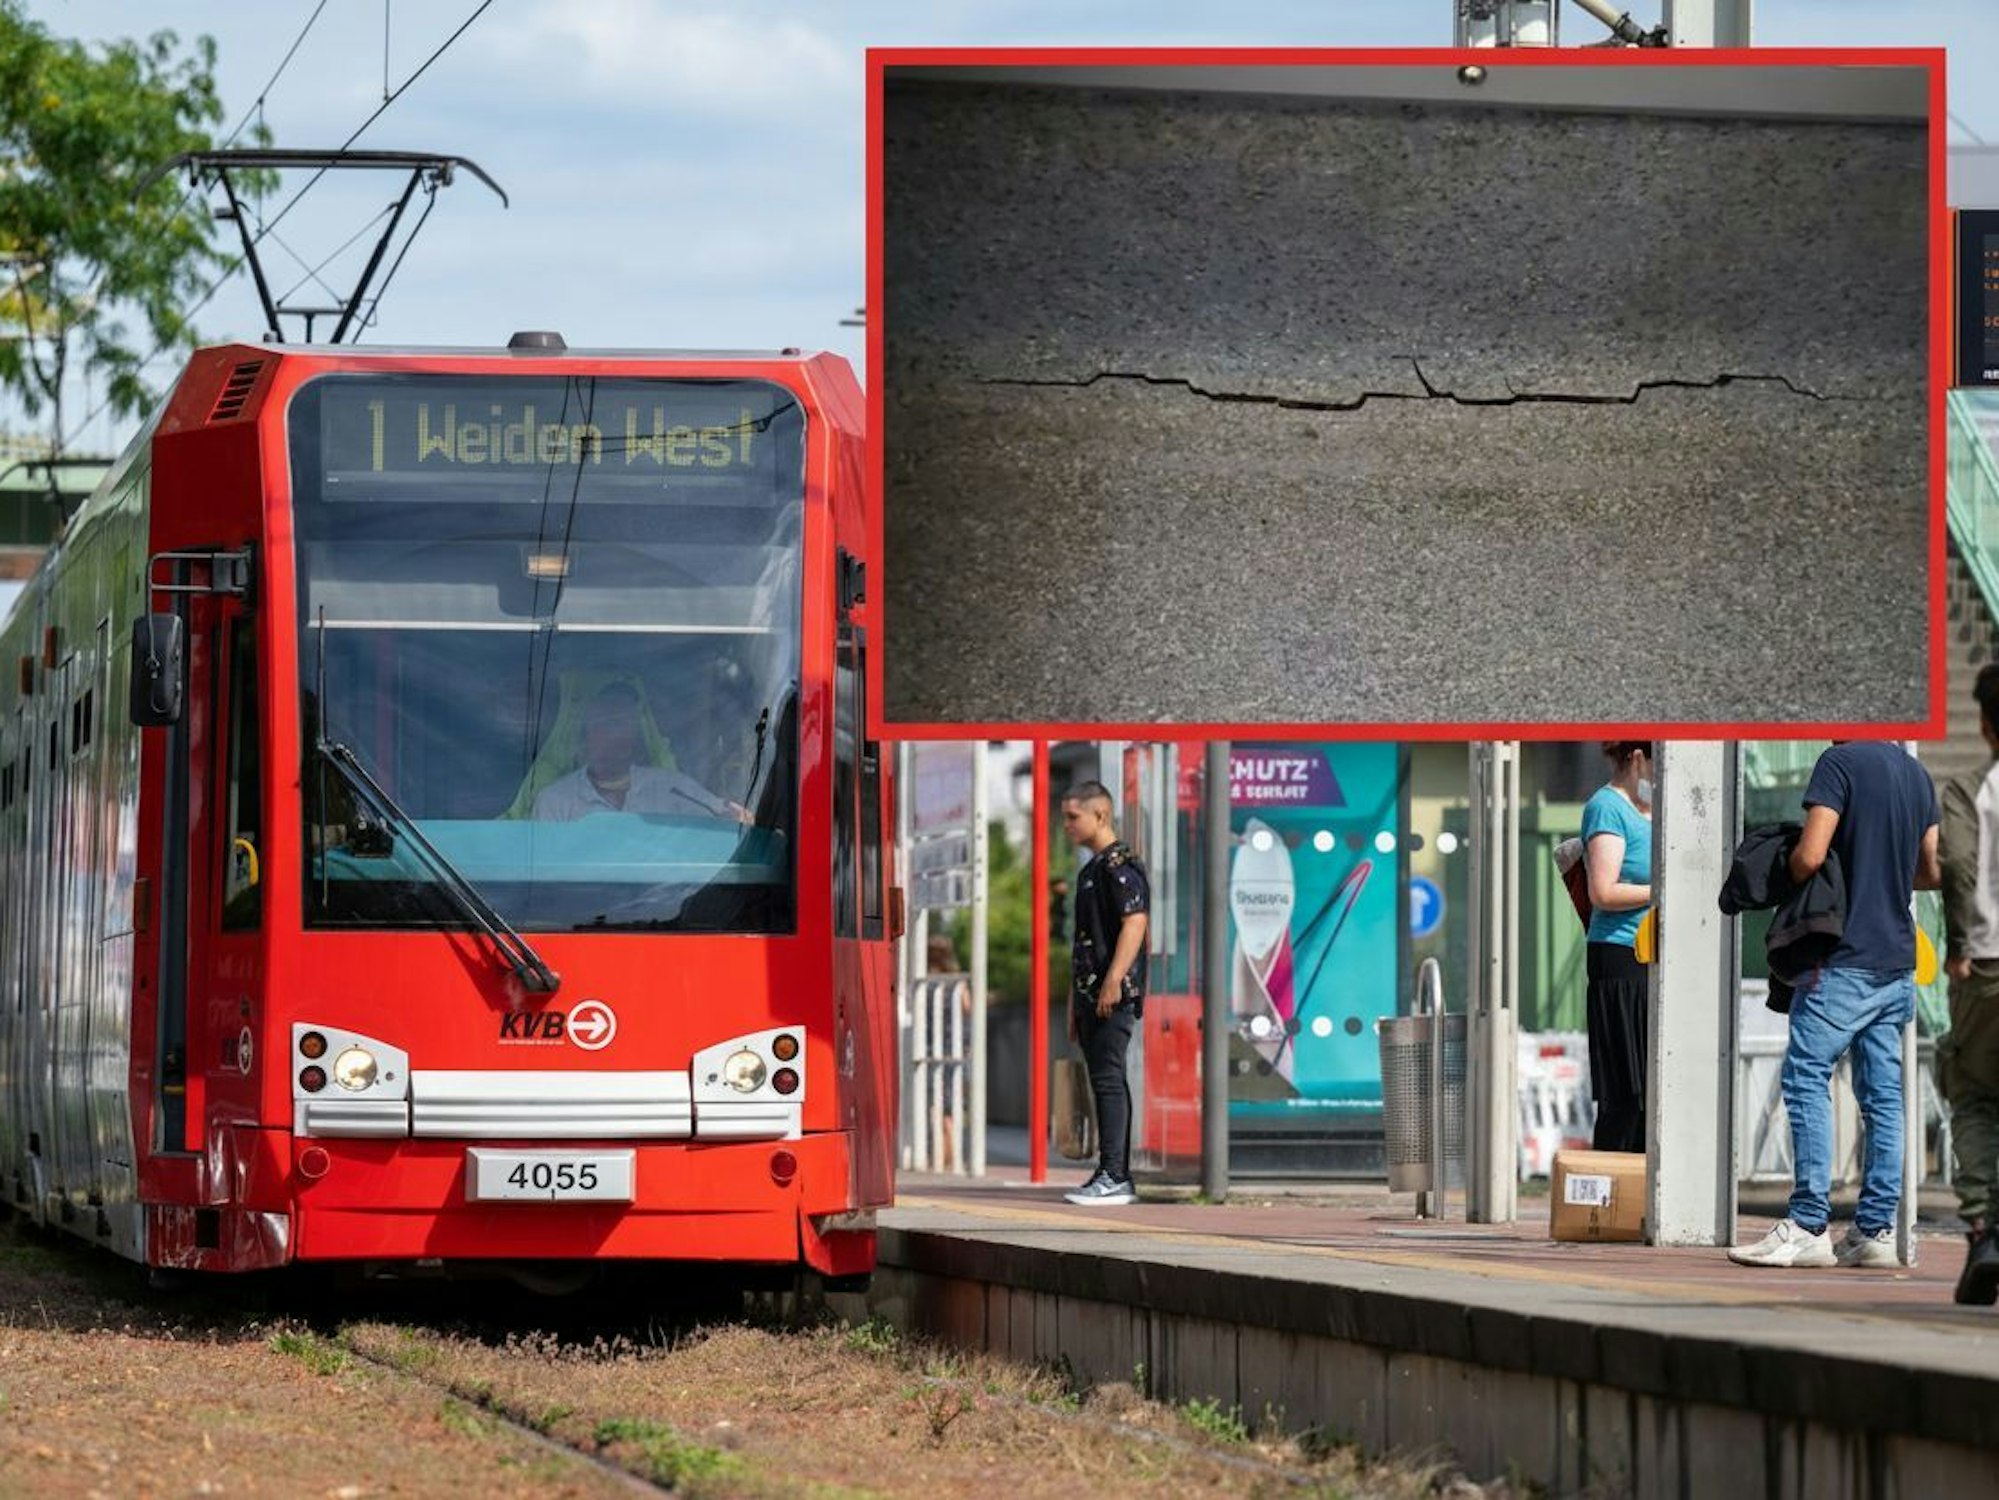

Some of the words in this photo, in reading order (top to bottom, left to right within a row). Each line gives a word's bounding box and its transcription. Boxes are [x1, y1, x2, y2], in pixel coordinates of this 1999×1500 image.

[368, 401, 385, 471] 1
[418, 402, 602, 464] Weiden
[626, 405, 755, 466] West
[500, 1011, 565, 1038] KVB
[507, 1162, 598, 1190] 4055
